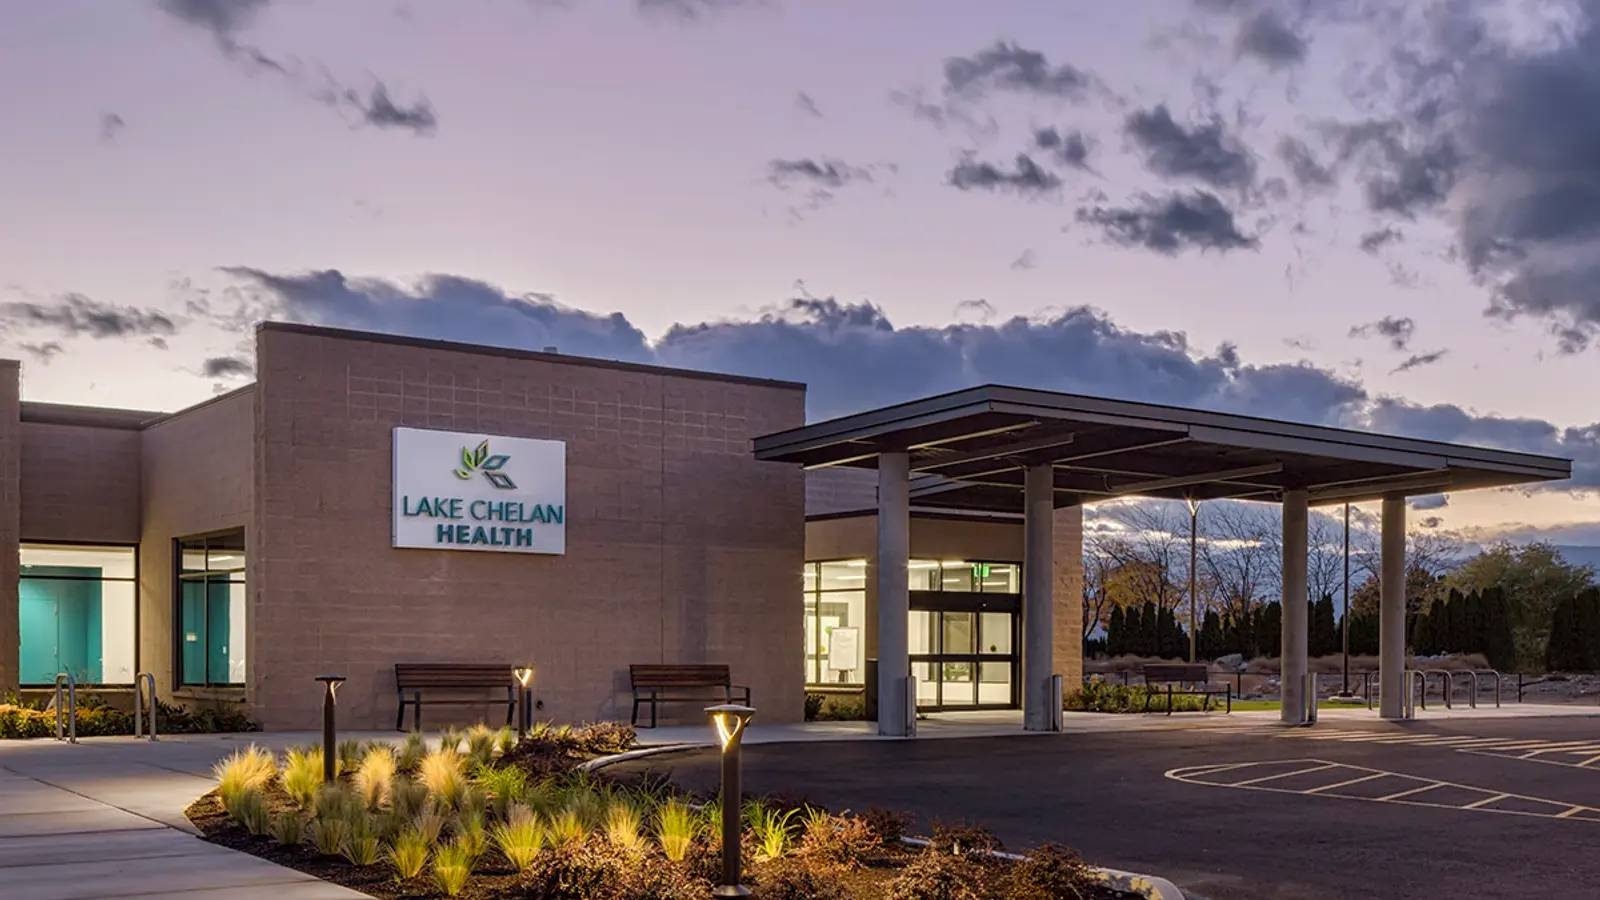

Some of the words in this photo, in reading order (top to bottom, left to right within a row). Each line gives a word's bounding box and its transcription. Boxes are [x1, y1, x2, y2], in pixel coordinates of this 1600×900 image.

[403, 495, 463, 519] LAKE
[470, 500, 563, 524] CHELAN
[437, 524, 532, 546] HEALTH
